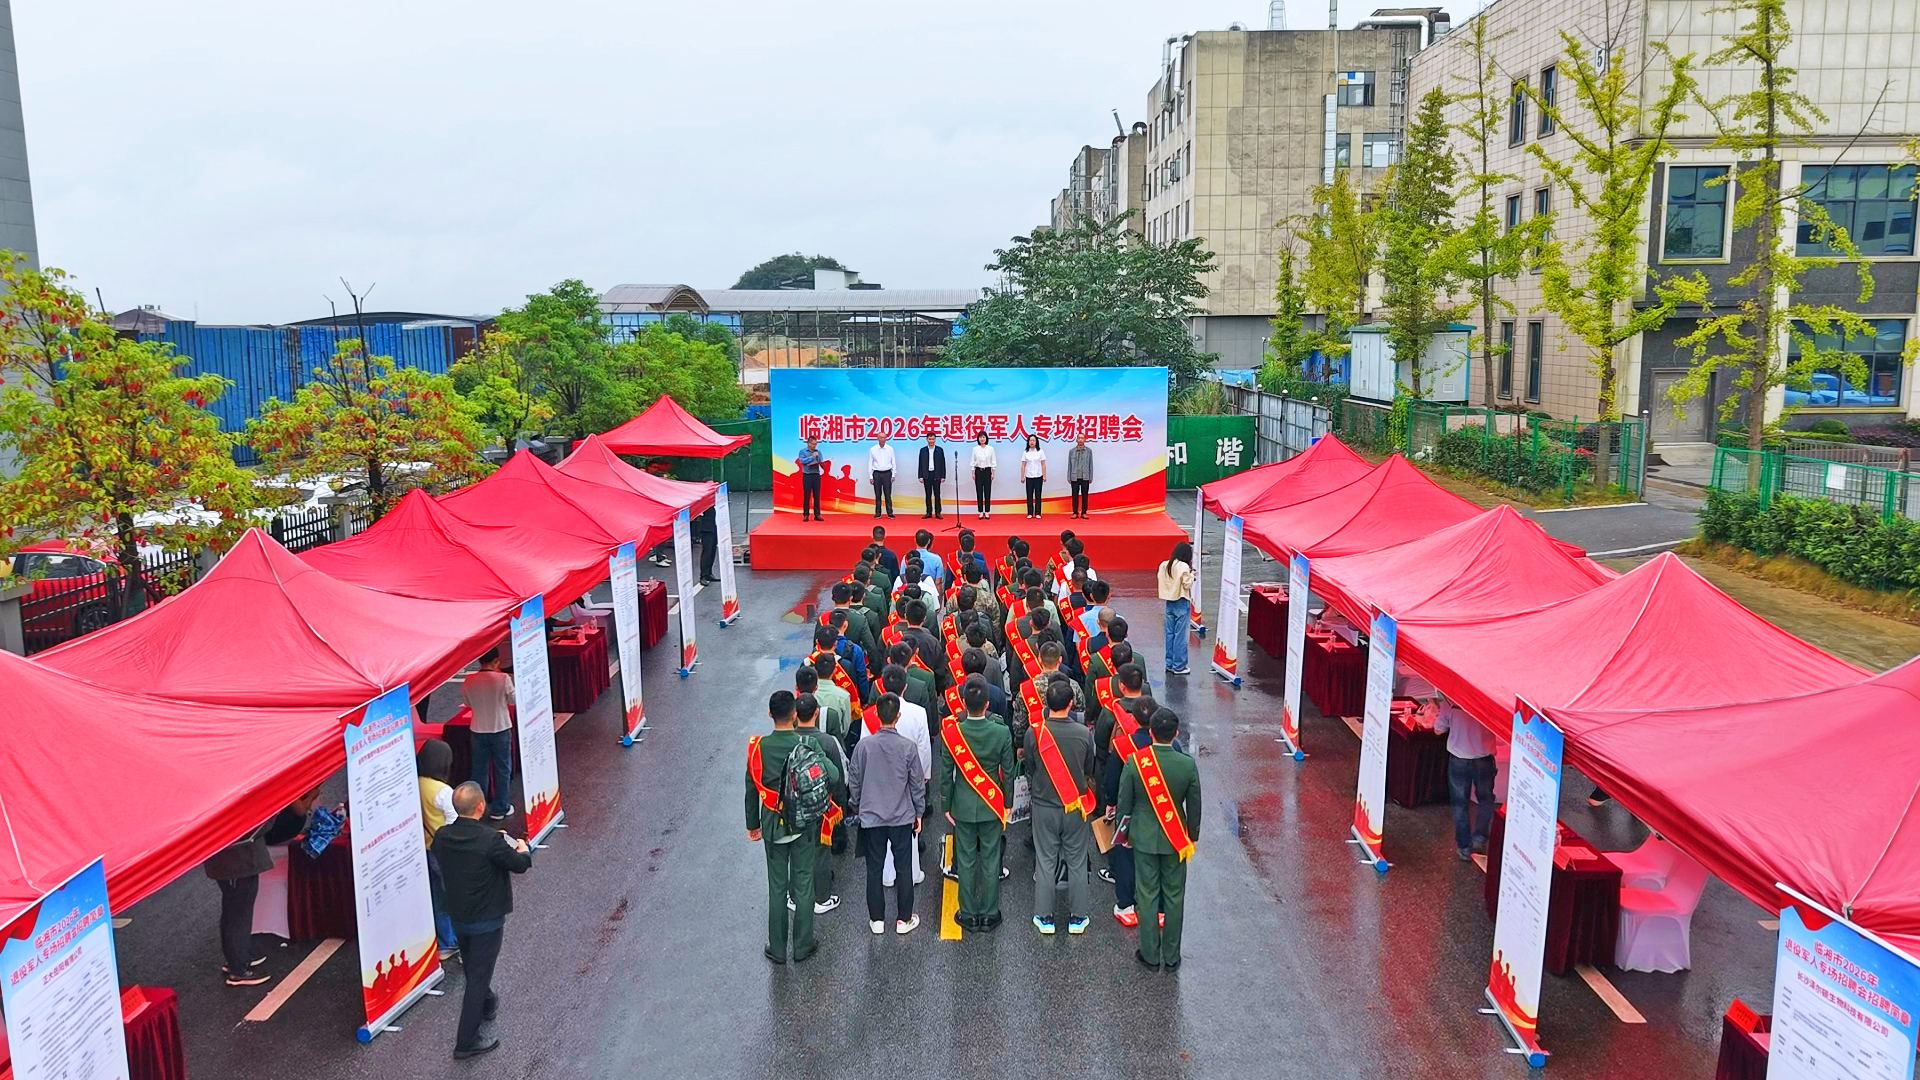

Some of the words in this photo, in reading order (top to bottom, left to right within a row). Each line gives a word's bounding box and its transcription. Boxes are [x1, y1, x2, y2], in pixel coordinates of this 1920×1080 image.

[1597, 50, 1602, 67] 5
[800, 414, 1144, 441] 临湘市2026年退役军人专场招聘会
[1784, 938, 1911, 1026] 退役军人专场招聘会招聘简章
[1814, 940, 1879, 988] 临湘市2026年
